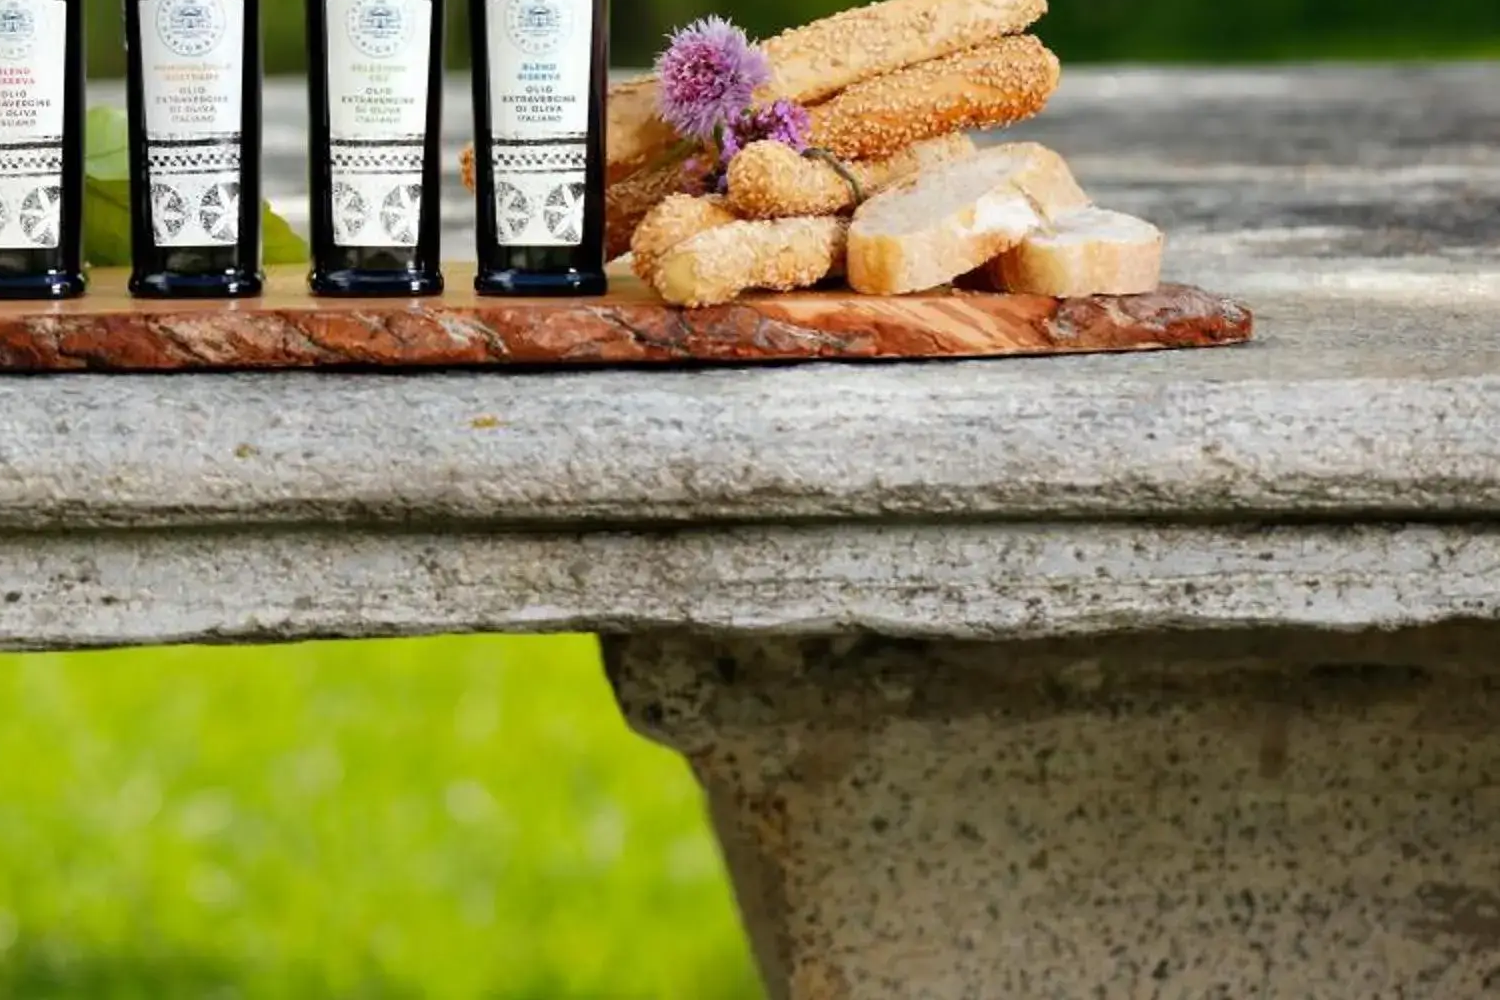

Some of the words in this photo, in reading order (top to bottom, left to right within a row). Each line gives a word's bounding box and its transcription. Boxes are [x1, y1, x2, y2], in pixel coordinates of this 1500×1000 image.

[521, 62, 557, 71] BLEND
[178, 86, 207, 95] OLIO
[364, 87, 393, 96] OLIO
[525, 85, 553, 94] OLIO
[1, 90, 28, 99] OLIO
[501, 95, 577, 104] EXTRAVERGINE
[5, 109, 38, 118] OLIVA
[515, 105, 527, 113] DI
[531, 105, 564, 113] OLIVA
[516, 114, 563, 123] ITALIANO
